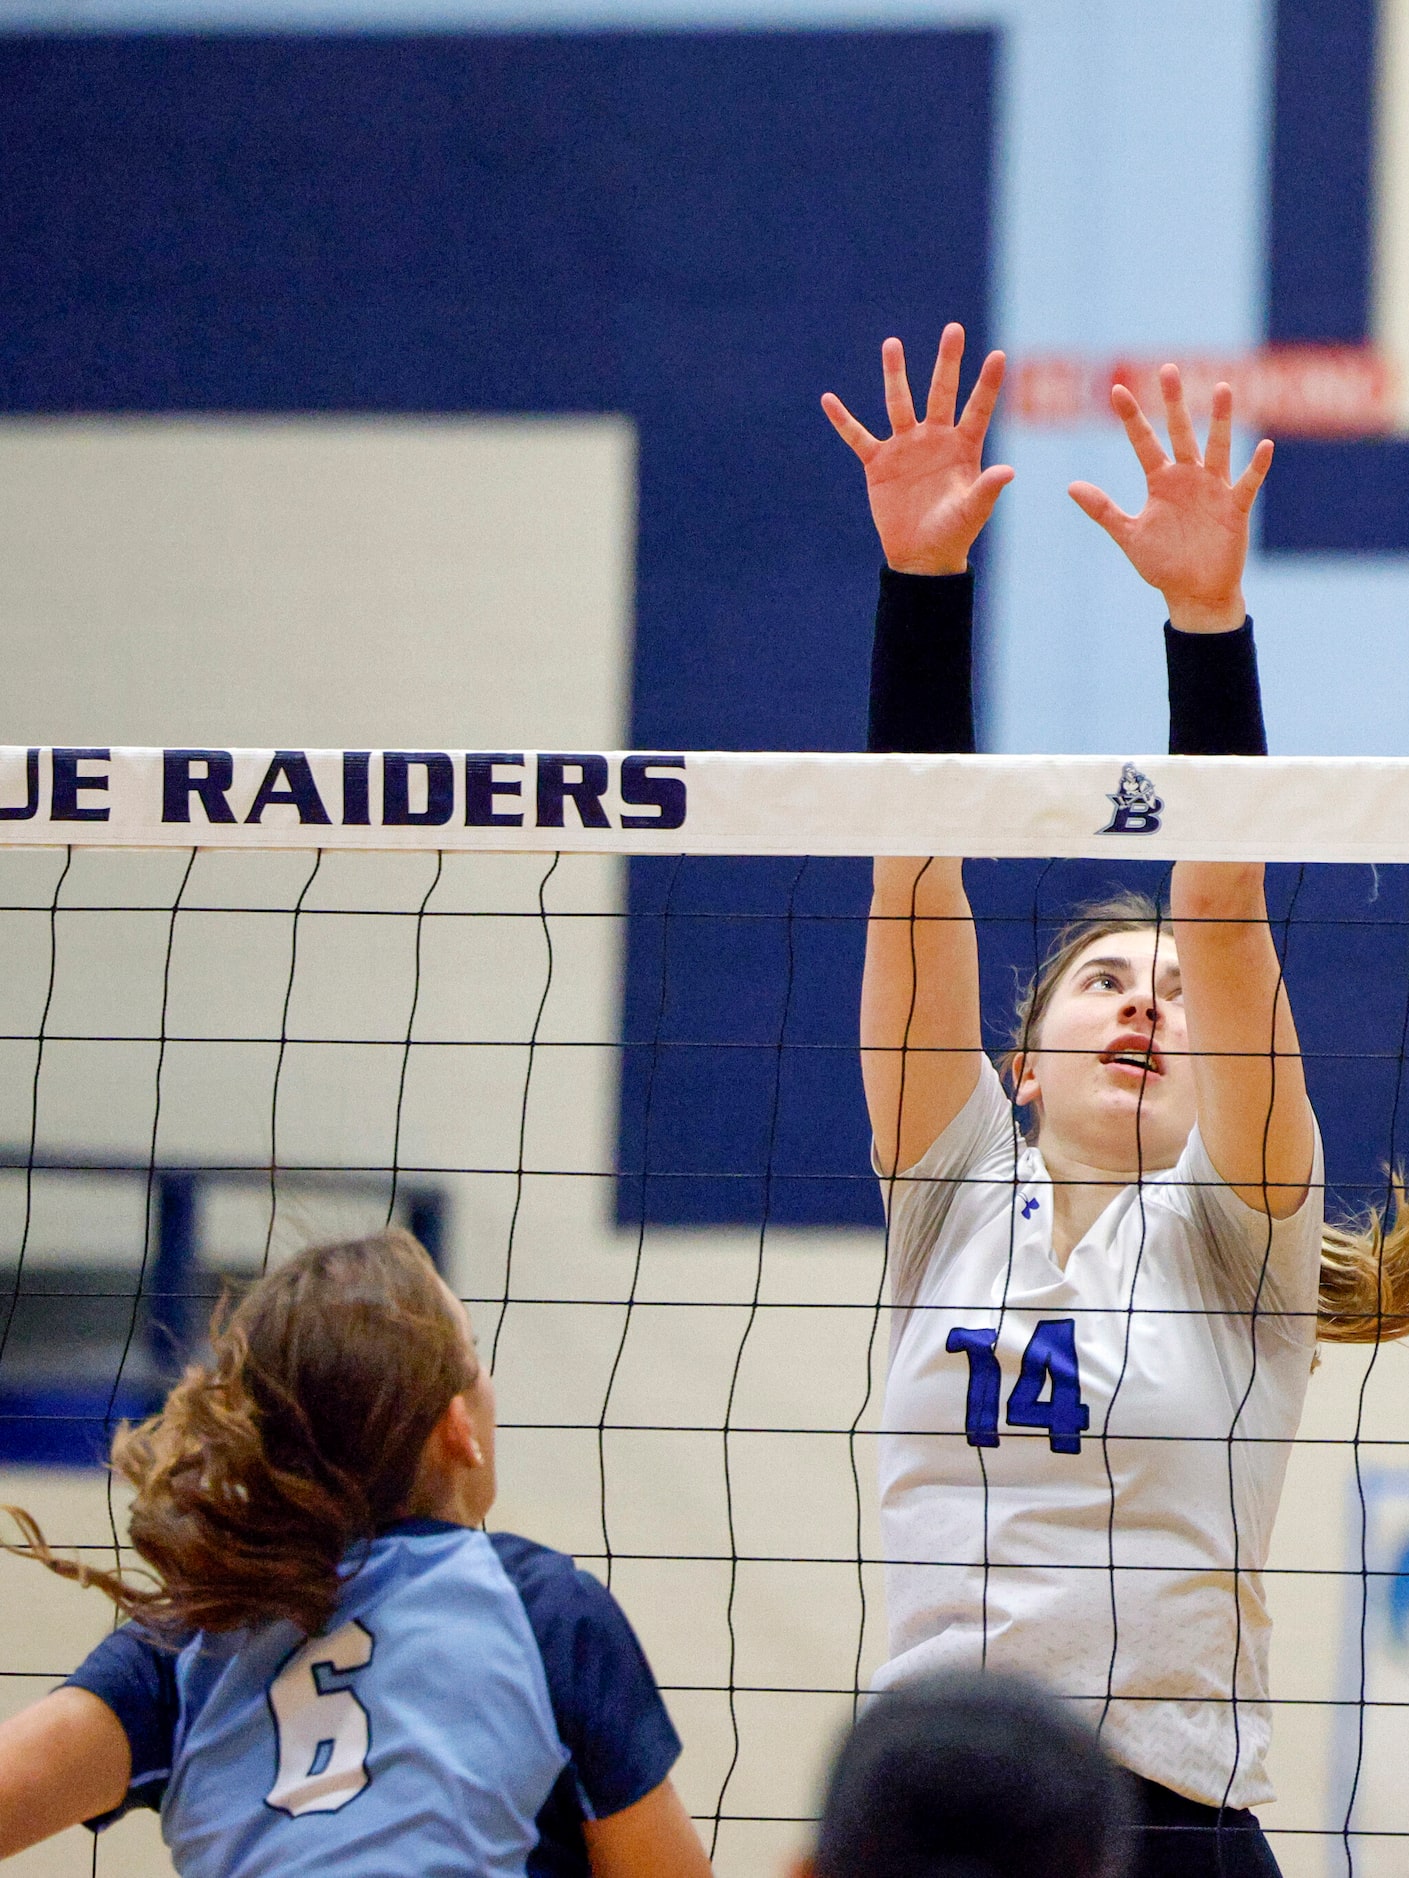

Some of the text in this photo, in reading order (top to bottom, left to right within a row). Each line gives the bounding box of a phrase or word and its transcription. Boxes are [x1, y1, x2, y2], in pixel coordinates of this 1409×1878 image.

[160, 748, 687, 829] RAIDERS
[946, 1318, 1090, 1454] 14
[263, 1617, 376, 1821] 6
